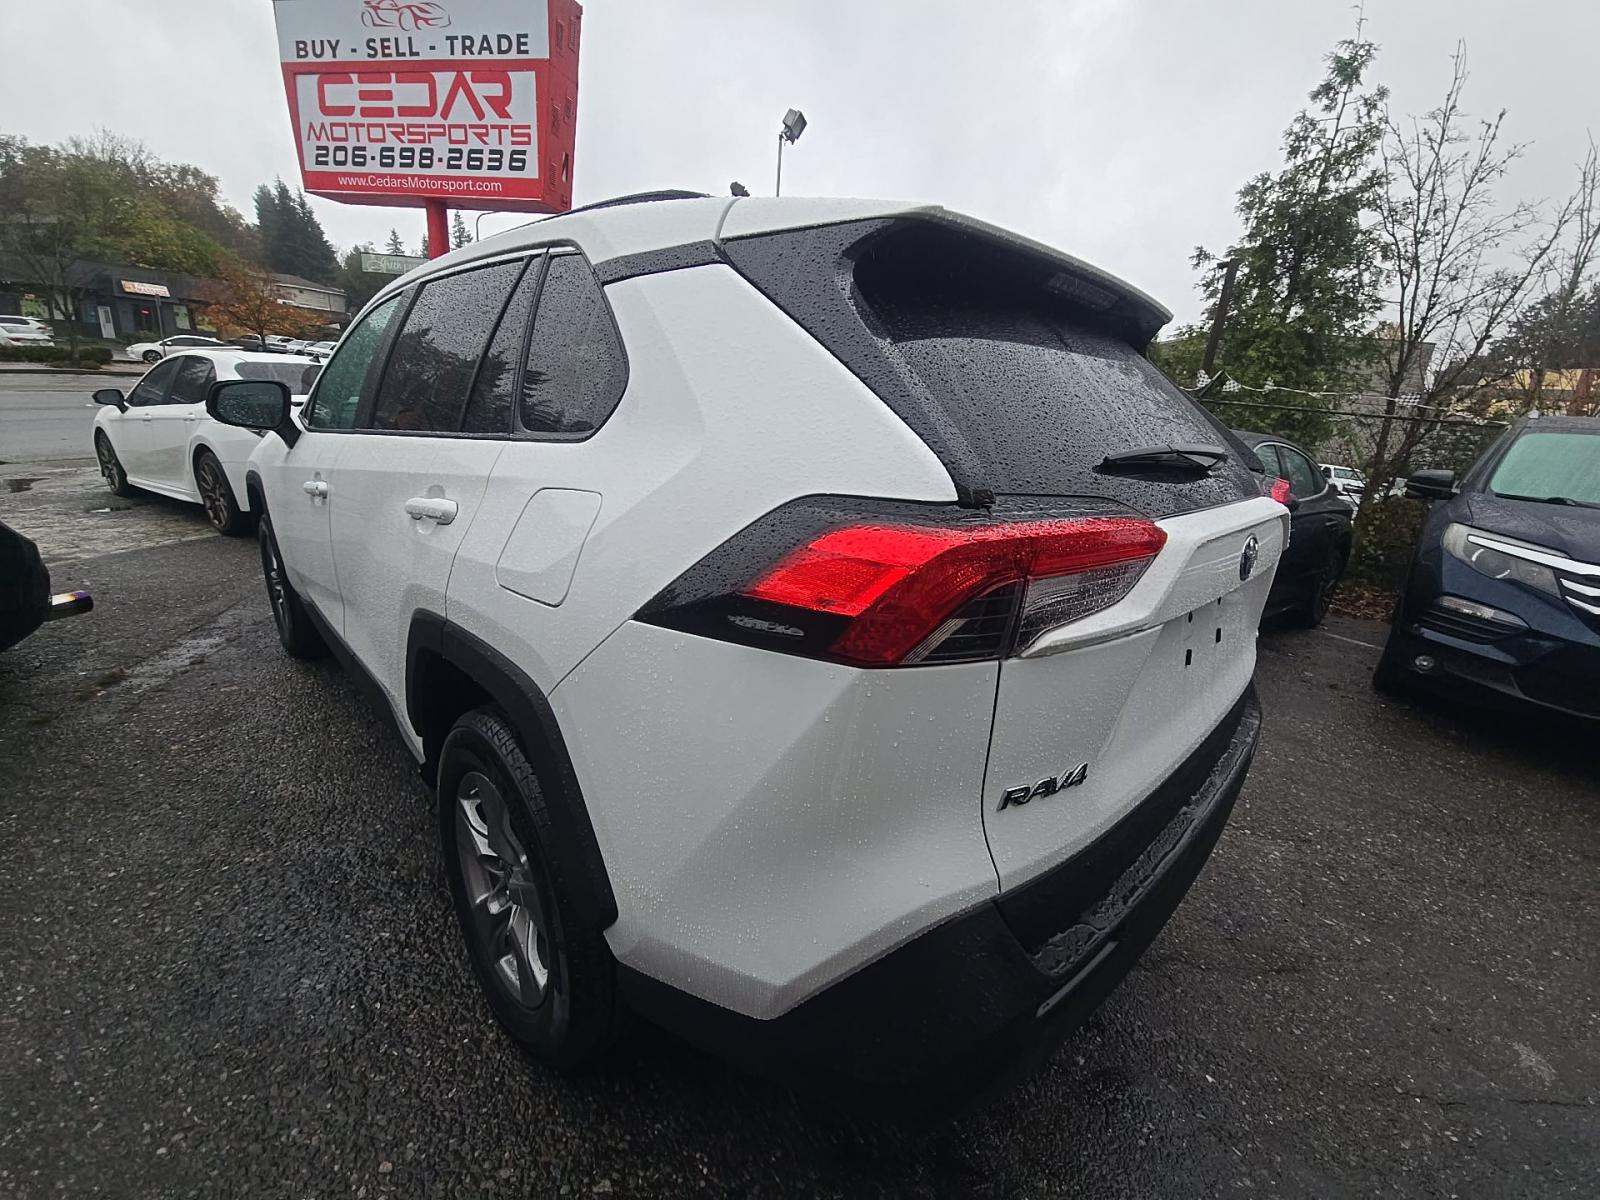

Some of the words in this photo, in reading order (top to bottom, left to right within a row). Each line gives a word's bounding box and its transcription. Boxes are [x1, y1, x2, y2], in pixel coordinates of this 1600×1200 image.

[295, 39, 341, 59] BUY
[366, 36, 420, 59] SELL
[445, 33, 530, 56] TRADE
[317, 70, 512, 121] CEDAR
[307, 122, 532, 146] MOTORSPORTS
[338, 175, 502, 192] www.CedarsMotorsport.com
[996, 762, 1088, 812] RAV4
